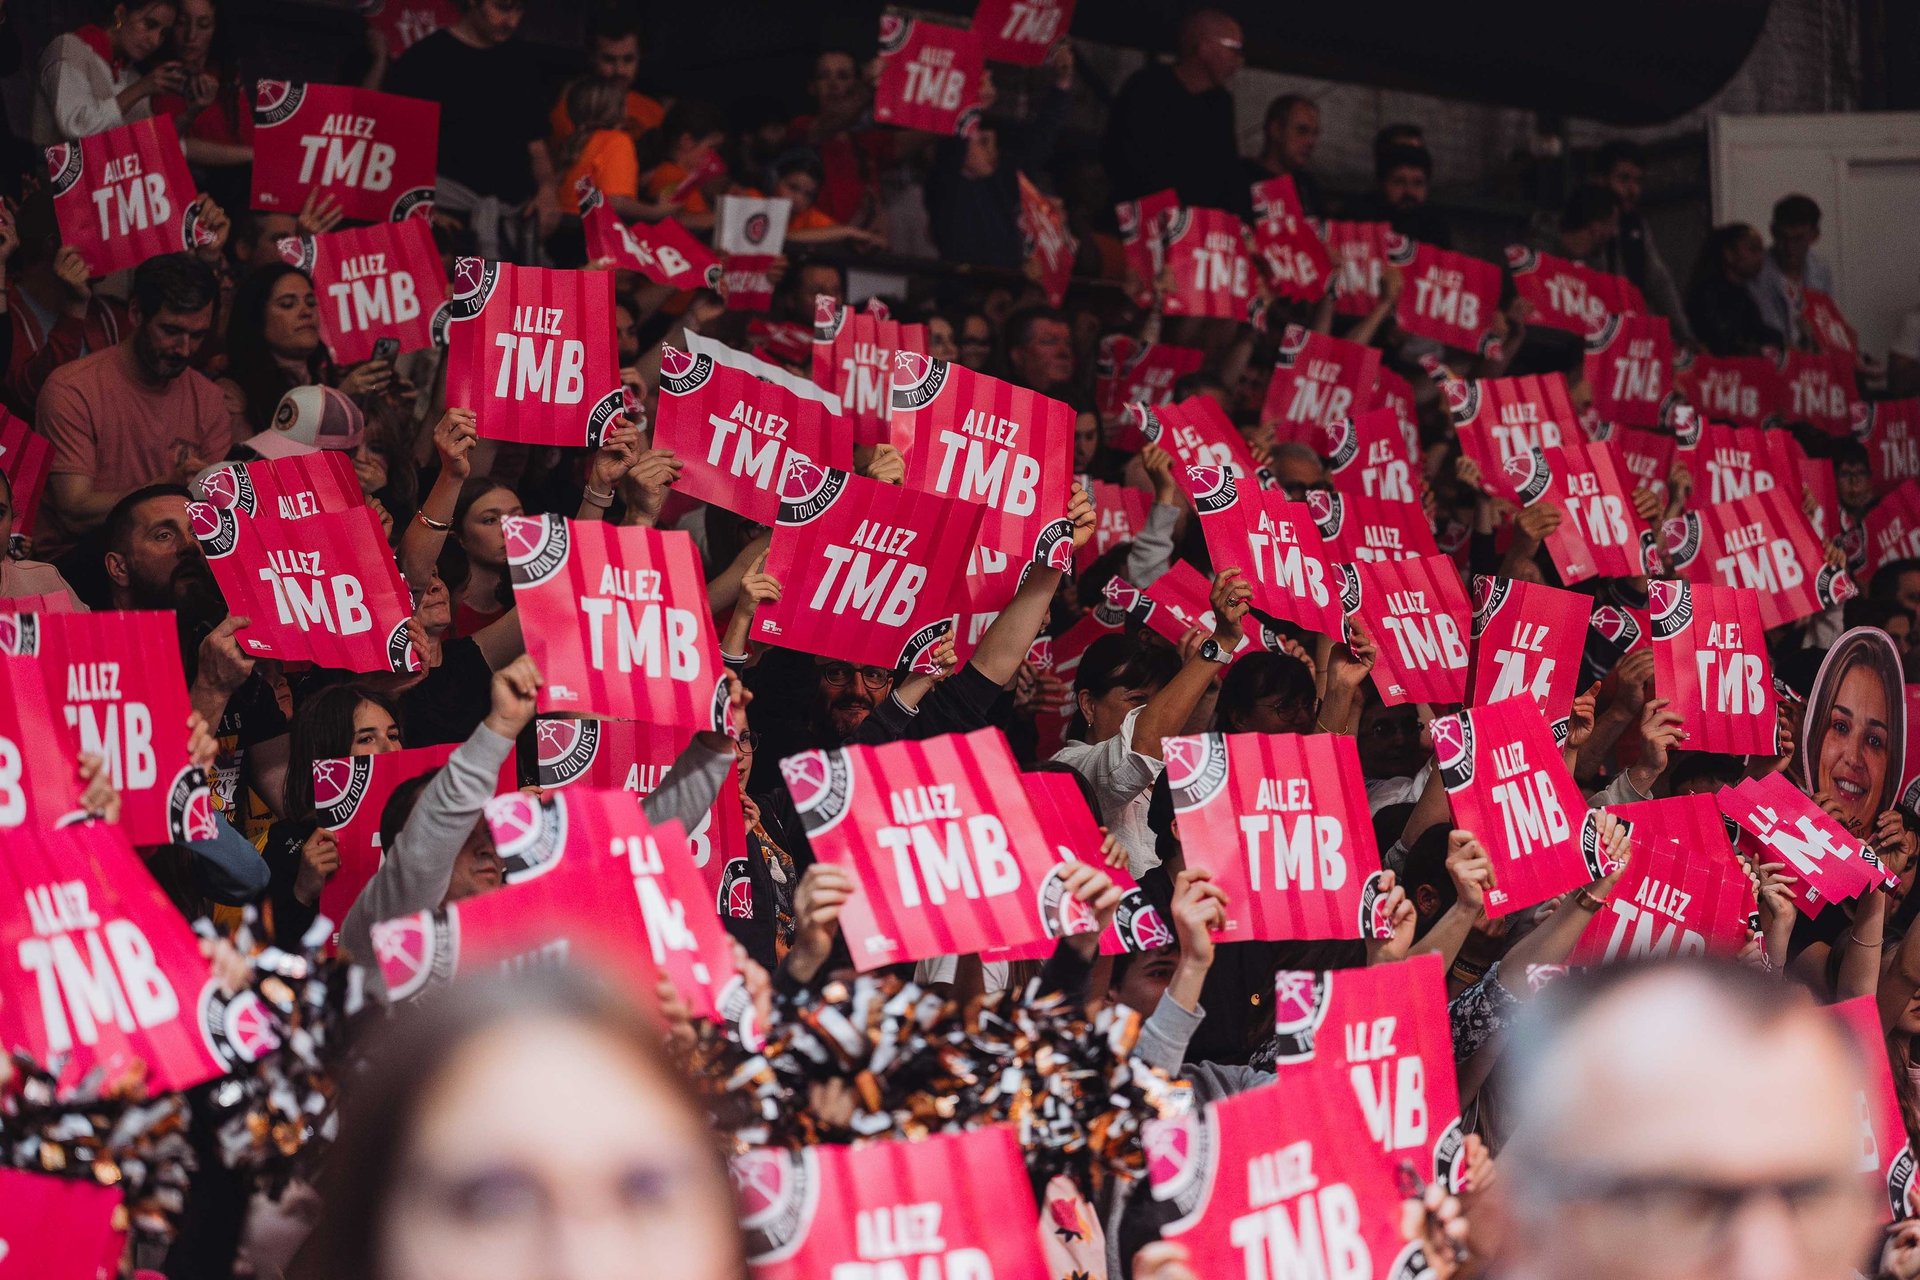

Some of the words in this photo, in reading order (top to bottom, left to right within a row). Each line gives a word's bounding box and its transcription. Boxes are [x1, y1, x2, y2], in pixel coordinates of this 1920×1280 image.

[902, 61, 967, 111] TMB
[320, 114, 376, 140] ALLEZ
[104, 153, 143, 184] ALLEZ
[297, 135, 397, 192] TMB
[92, 172, 171, 241] TMB
[341, 253, 387, 281] ALLEZ
[329, 271, 420, 334] TMB
[514, 306, 563, 335] ALLEZ
[1415, 278, 1481, 331] TMB
[495, 333, 584, 404] TMB
[670, 358, 710, 391] TOULOUSE
[905, 365, 944, 406] TOULOUSE
[592, 400, 612, 425] TMB
[729, 400, 789, 441] ALLEZ
[1700, 376, 1760, 418] TMB
[1790, 380, 1848, 420] TMB
[961, 409, 1020, 449] ALLEZ
[935, 429, 1040, 517] TMB
[792, 475, 841, 521] TOULOUSE
[522, 521, 566, 581] TOULOUSE
[849, 520, 918, 557] ALLEZ
[1042, 524, 1062, 545] TMB
[1364, 526, 1403, 548] ALLEZ
[1724, 521, 1767, 554] ALLEZ
[599, 563, 663, 602] ALLEZ
[809, 544, 927, 627] TMB
[1249, 533, 1329, 607] TMB
[1715, 537, 1804, 594] TMB
[258, 573, 373, 636] TMB
[1386, 590, 1430, 616] ALLEZ
[1659, 584, 1692, 636] TOULOUSE
[580, 595, 700, 683] TMB
[910, 628, 934, 650] TMB
[1383, 613, 1469, 671] TMB
[67, 662, 122, 702] ALLEZ
[1696, 650, 1766, 716] TMB
[552, 726, 597, 780] TOULOUSE
[1184, 740, 1226, 803] TOULOUSE
[330, 763, 368, 823] TOULOUSE
[623, 763, 672, 793] ALLE
[1256, 778, 1312, 811] ALLEZ
[890, 783, 963, 826] ALLEZ
[1492, 769, 1570, 860] TMB
[876, 814, 1021, 909] TMB
[1239, 814, 1347, 892] TMB
[1634, 876, 1693, 923] ALLEZ
[18, 918, 180, 1054] TMB
[1892, 1155, 1914, 1190] TMB
[1229, 1182, 1374, 1280] TMB
